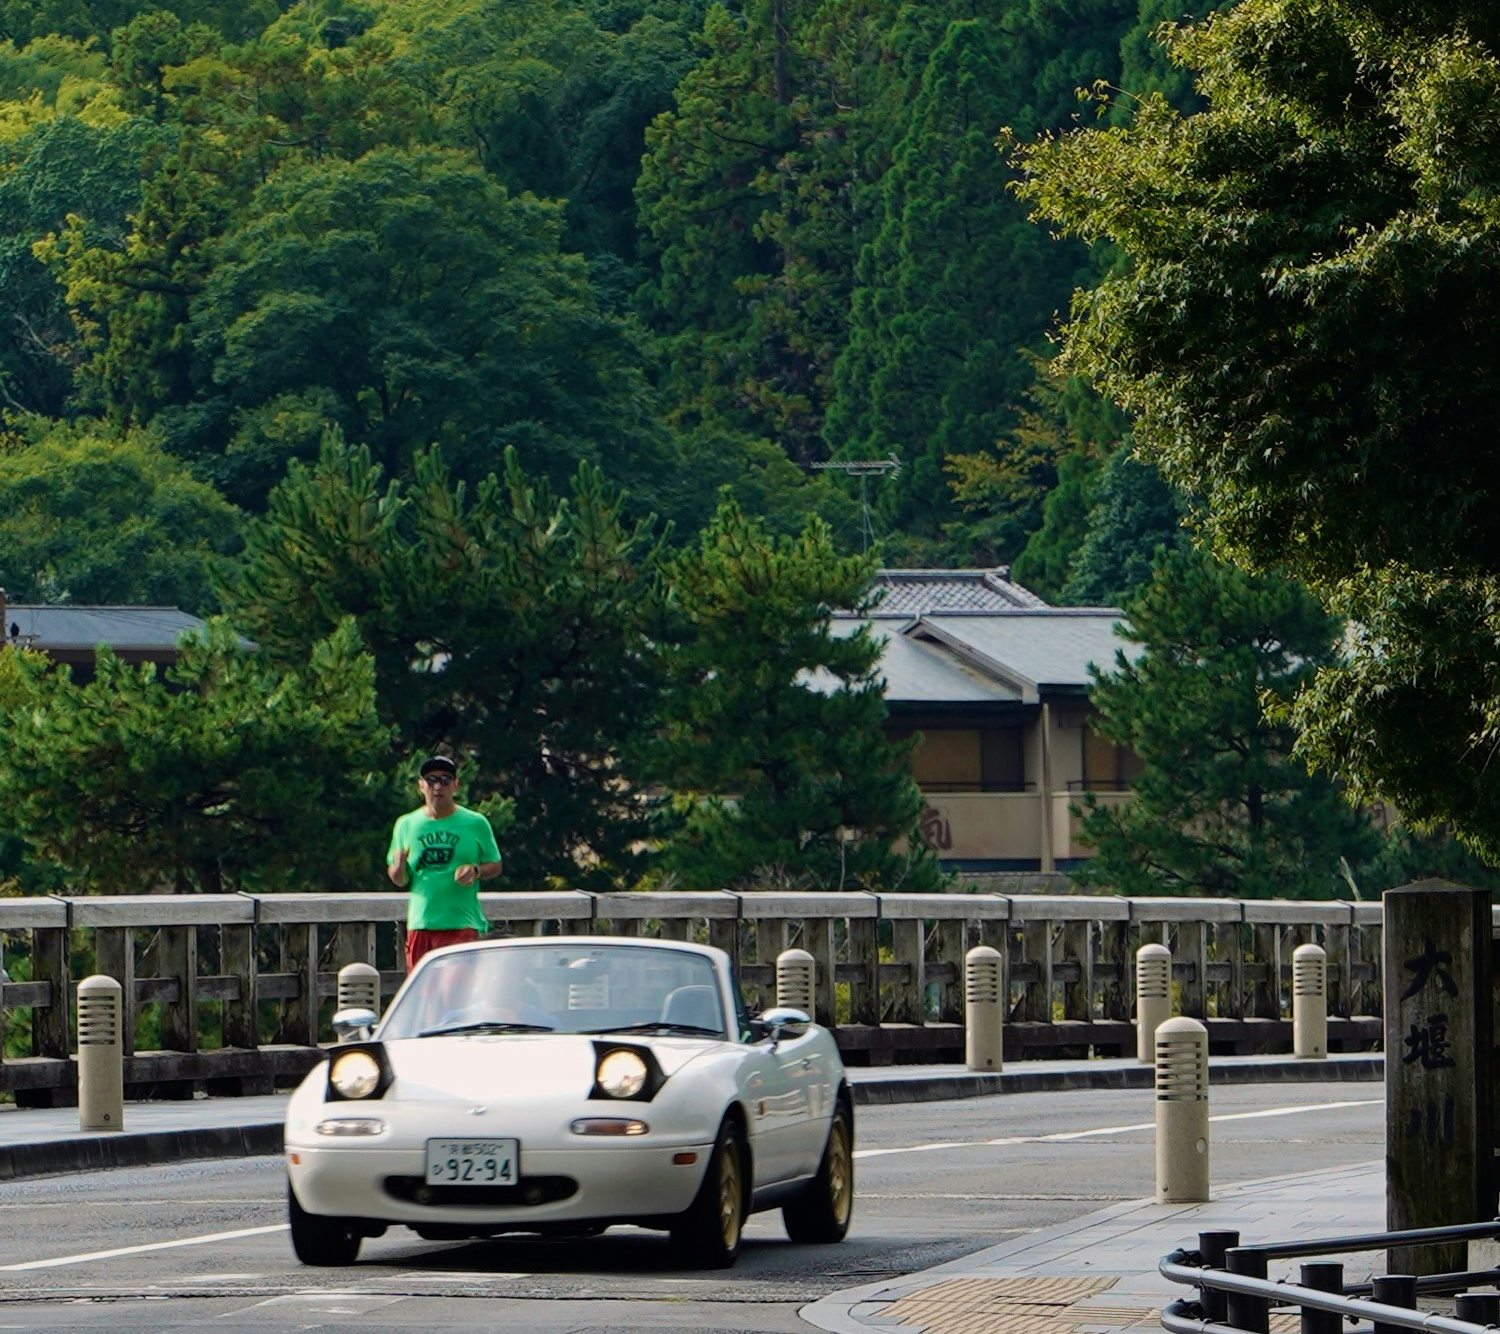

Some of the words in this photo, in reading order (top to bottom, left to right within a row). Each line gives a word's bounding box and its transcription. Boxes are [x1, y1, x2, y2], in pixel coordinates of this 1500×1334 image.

[418, 832, 460, 847] TOKYO
[1399, 937, 1460, 1149] 大堰川
[446, 1158, 511, 1181] 92-94
